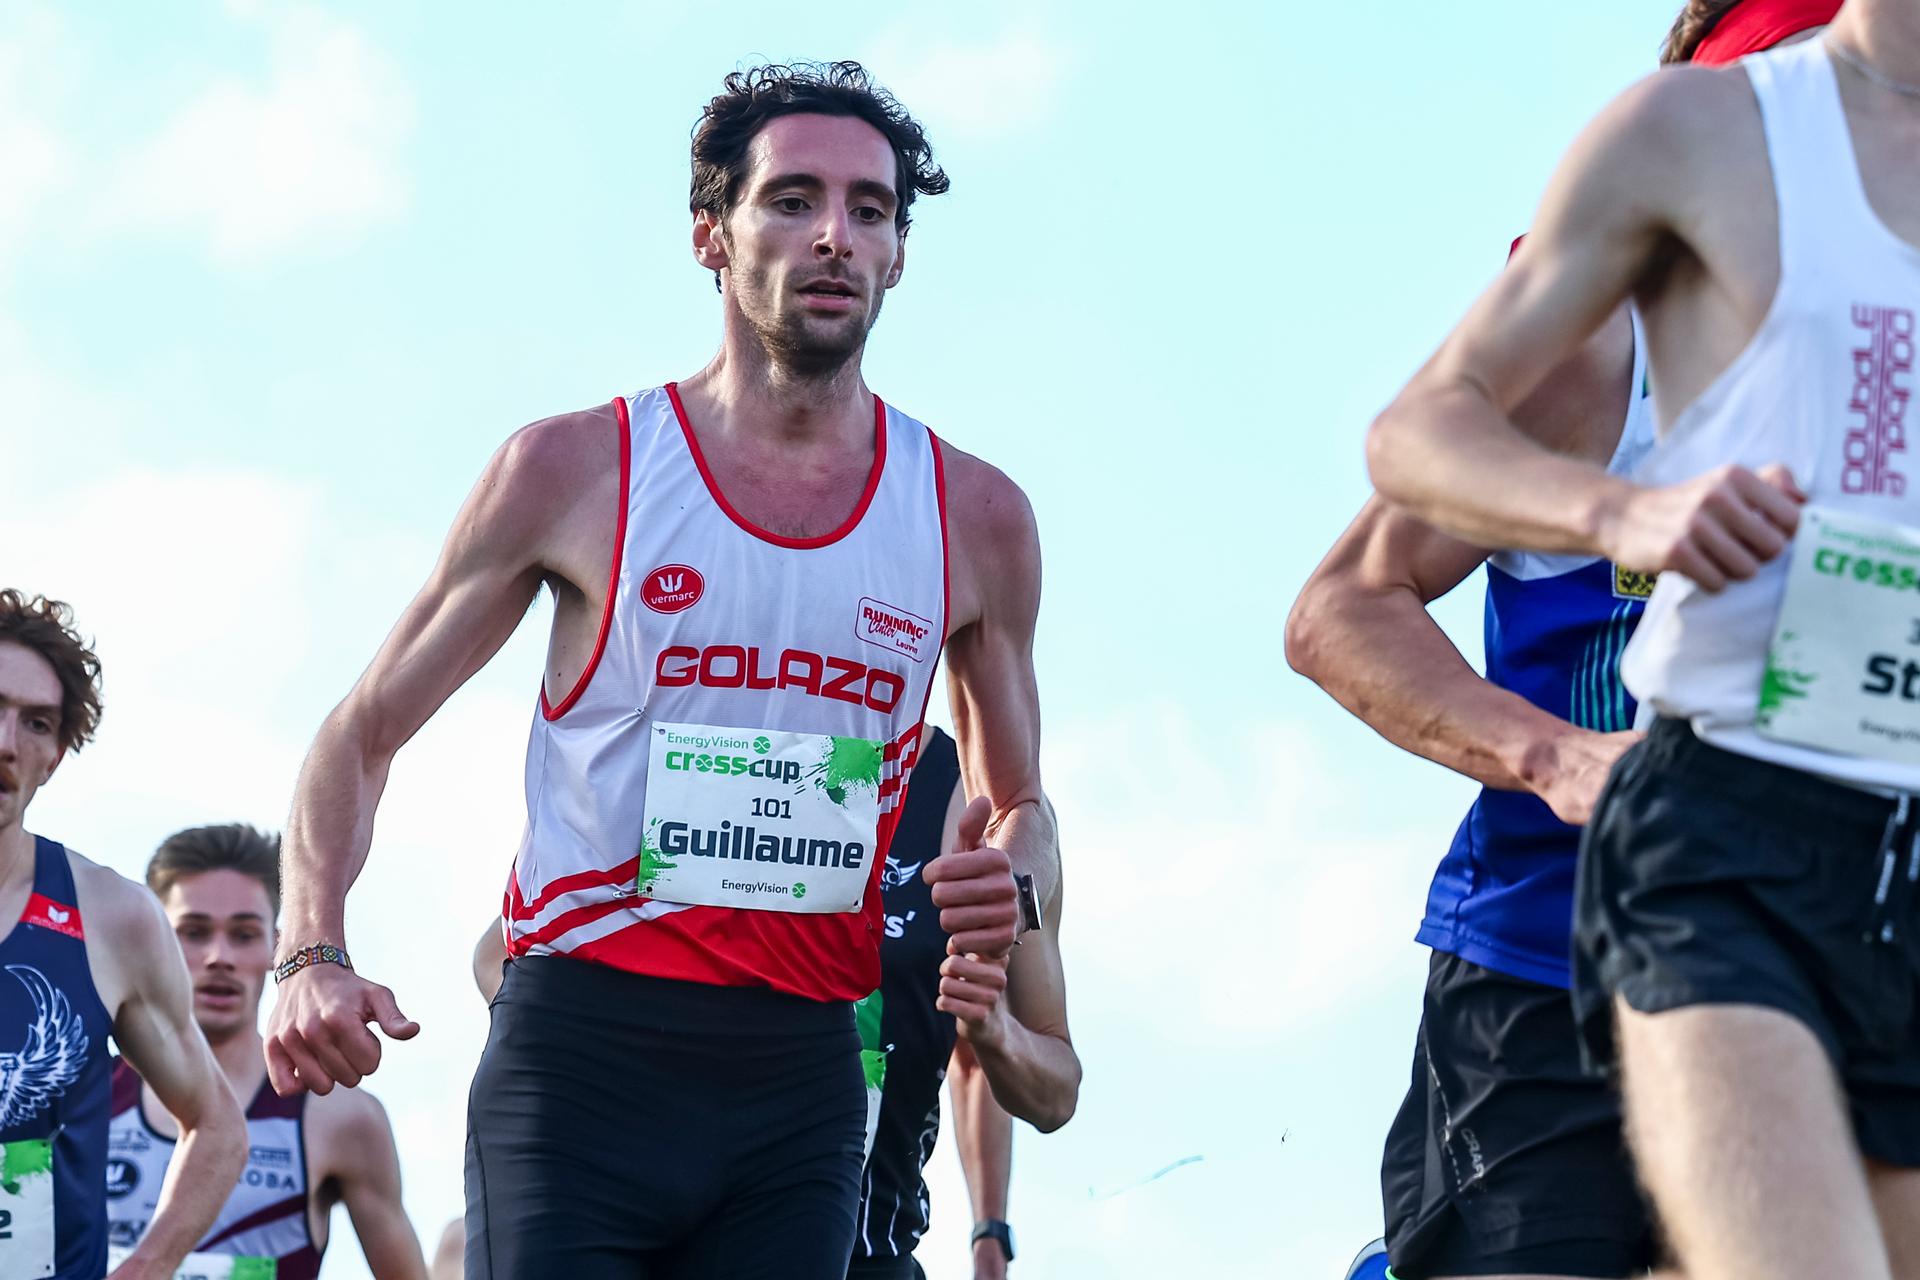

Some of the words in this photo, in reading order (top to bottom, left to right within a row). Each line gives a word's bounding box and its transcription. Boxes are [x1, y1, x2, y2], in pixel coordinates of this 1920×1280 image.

[651, 591, 695, 605] vermarc
[655, 644, 906, 715] GOLAZO
[667, 732, 749, 750] EnergyVision
[751, 797, 792, 819] 101
[659, 820, 865, 869] Guillaume
[721, 879, 788, 896] EnergyVision
